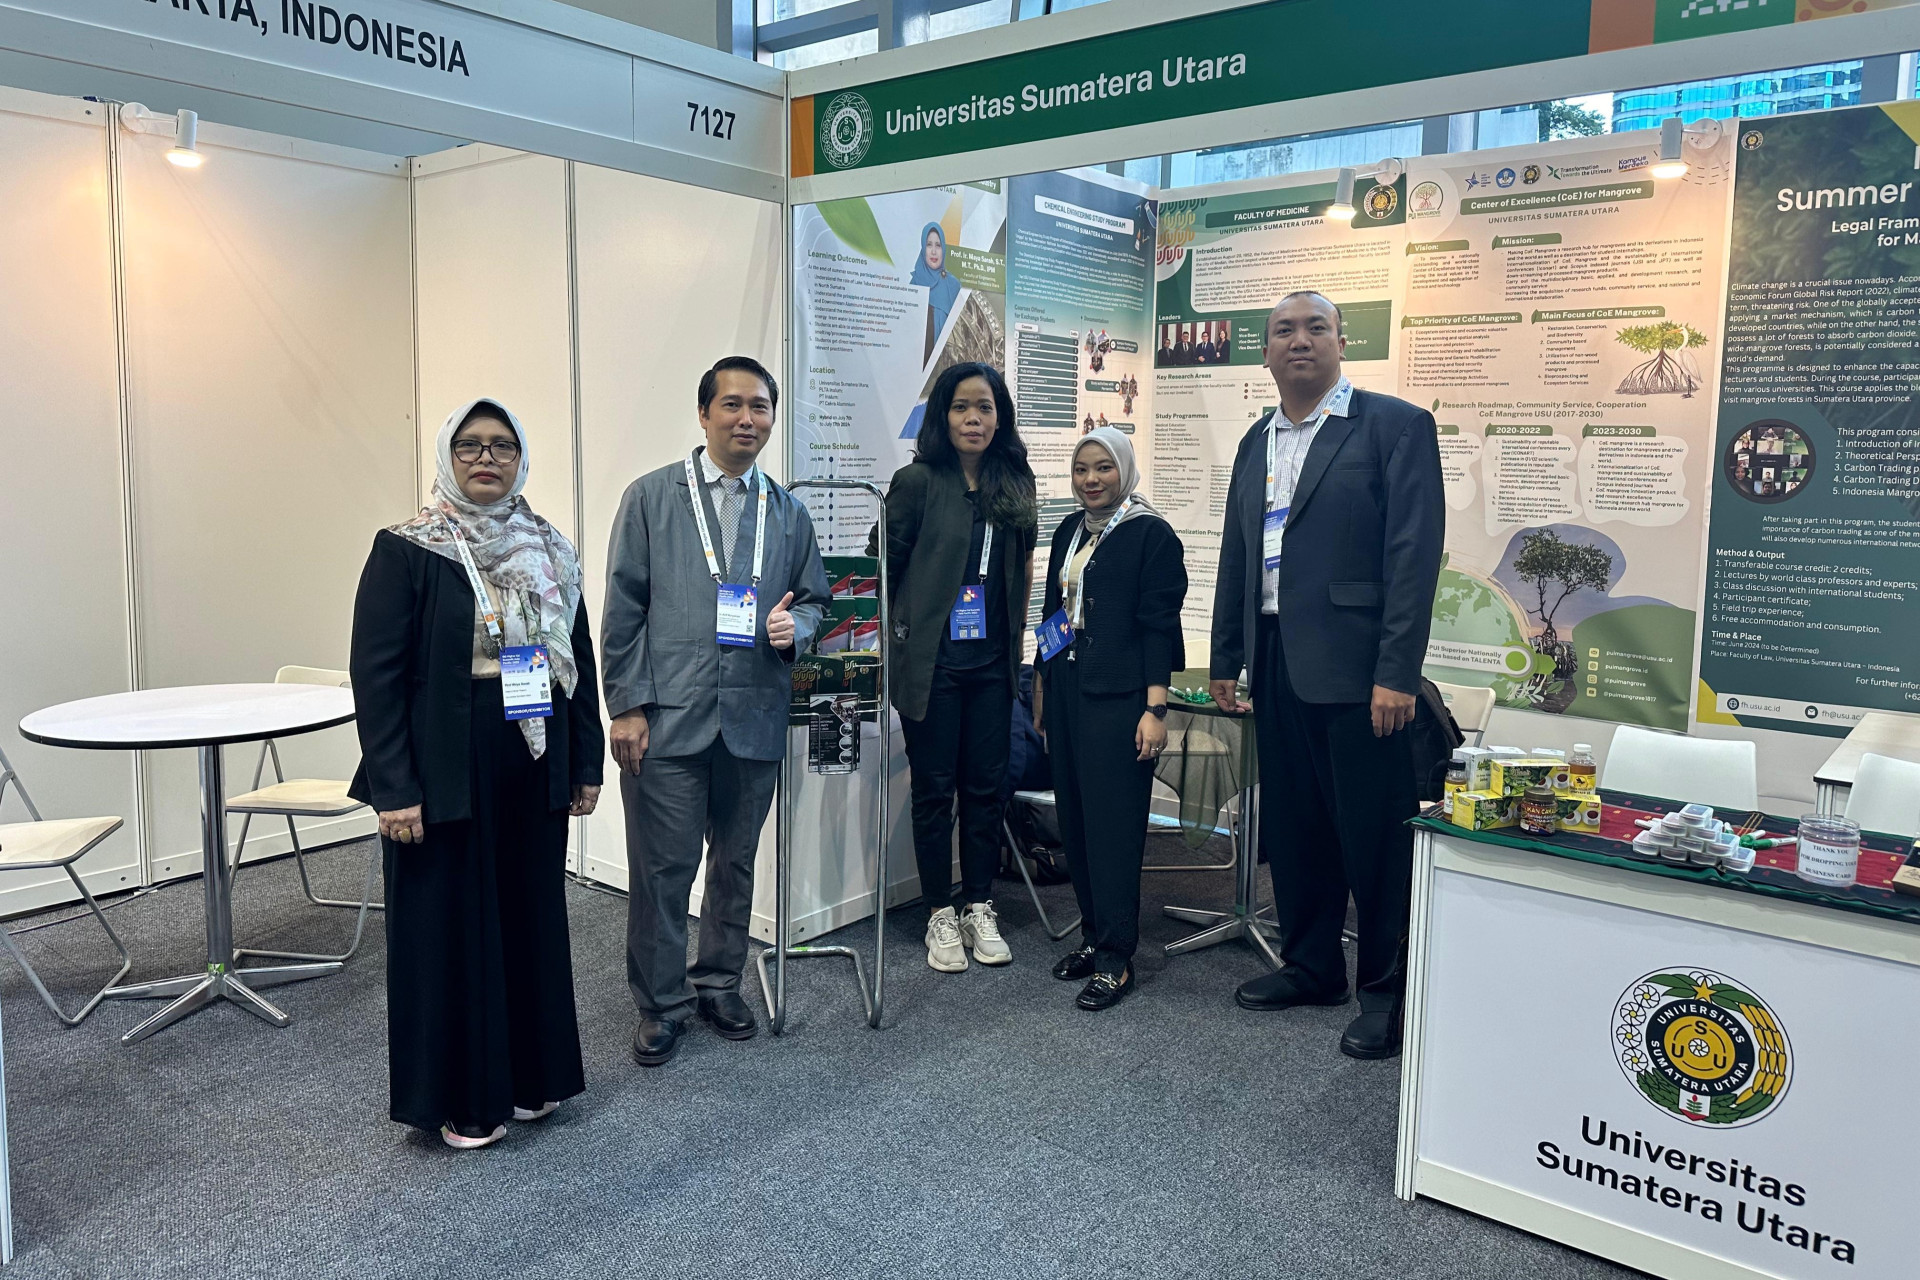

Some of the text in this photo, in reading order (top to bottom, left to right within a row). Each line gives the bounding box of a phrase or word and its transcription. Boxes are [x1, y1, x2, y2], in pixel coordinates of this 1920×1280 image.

[282, 0, 470, 76] INDONESIA
[886, 94, 1016, 136] Universitas
[1021, 69, 1153, 112] Sumatera
[1163, 51, 1246, 86] Utara
[687, 101, 736, 140] 7127
[1560, 164, 1599, 173] Transformation
[1619, 155, 1646, 167] Kampus
[1619, 160, 1649, 171] Merdeka
[1471, 186, 1642, 210] Center of Excellence (CoE) for Mangrove
[1777, 181, 1912, 212] Summer
[1045, 202, 1126, 228] CHEMICAL ENGINEERING STUDY PROGRAM
[1234, 206, 1309, 221] FACULTY OF MEDICINE
[1488, 206, 1619, 224] UNIVERSITAS SUMATERA UTARA
[1056, 221, 1079, 232] UNIVERSITAS
[1080, 228, 1100, 238] SUMATERA
[1220, 218, 1324, 235] UNIVERSITAS SUMATERA UTARA
[1832, 218, 1873, 234] Legal
[1502, 237, 1534, 245] Mission:
[1877, 235, 1900, 247] for
[808, 249, 867, 265] Learning Outcomes
[951, 250, 962, 258] Prof.
[969, 253, 981, 262] Maya
[981, 256, 995, 265] Sarah,
[996, 258, 1005, 266] S.T.,
[1196, 246, 1232, 255] Introduction
[987, 265, 995, 273] IPM
[1410, 318, 1423, 326] Top
[1425, 317, 1451, 325] Priority
[1462, 315, 1477, 323] CoE
[1479, 314, 1518, 323] Mangrove:
[1562, 311, 1584, 319] Focus
[1586, 310, 1594, 318] of
[1596, 309, 1613, 317] CoE
[1615, 308, 1659, 318] Mangrove:
[809, 366, 835, 374] Location
[1478, 401, 1514, 410] Roadmap,
[1516, 401, 1562, 410] Community
[1563, 401, 1594, 409] Service,
[1596, 401, 1647, 409] Cooperation
[1479, 410, 1604, 419] CoE Mangrove USU (2017-2030)
[1716, 548, 1785, 564] Method & Output
[1724, 560, 1774, 570] Transferable
[1775, 563, 1803, 572] course
[1805, 564, 1831, 573] credit:
[1833, 565, 1839, 573] 2
[1840, 566, 1872, 576] credits;
[1723, 571, 1757, 580] Lectures
[1759, 572, 1769, 582] by
[1771, 574, 1794, 582] world
[1796, 575, 1816, 583] class
[1818, 575, 1862, 587] professors
[1865, 578, 1881, 587] and
[1883, 579, 1918, 590] experts;
[1723, 582, 1744, 590] Class
[1745, 583, 1787, 593] discussion
[1789, 586, 1806, 594] with
[1808, 587, 1861, 597] international
[1864, 591, 1904, 601] students;
[1722, 593, 1765, 605] Participant
[1767, 596, 1811, 607] certificate;
[1721, 604, 1740, 613] Field
[1742, 605, 1756, 615] trip
[1758, 607, 1804, 618] experience;
[1721, 615, 1738, 623] Free
[1740, 617, 1804, 628] accommodation
[1806, 621, 1822, 629] and
[1824, 623, 1881, 634] consumption.
[1712, 631, 1731, 639] Time
[1740, 633, 1762, 641] Place
[1441, 646, 1467, 654] Superior
[1468, 649, 1501, 658] Nationally
[1471, 657, 1500, 665] TALENTA
[1604, 678, 1646, 687] @puimangrove
[1741, 701, 1781, 713] fh.usu.ac.id
[1813, 845, 1835, 854] THANK
[1811, 857, 1844, 866] DROPPING
[1806, 867, 1835, 878] BUSINESS
[1656, 1004, 1745, 1043] UNIVERSITAS
[1651, 1040, 1709, 1092] SUMATERA
[1714, 1061, 1748, 1091] UTARA
[1580, 1114, 1807, 1207] Universitas
[1536, 1141, 1855, 1265] Sumatera Utara
